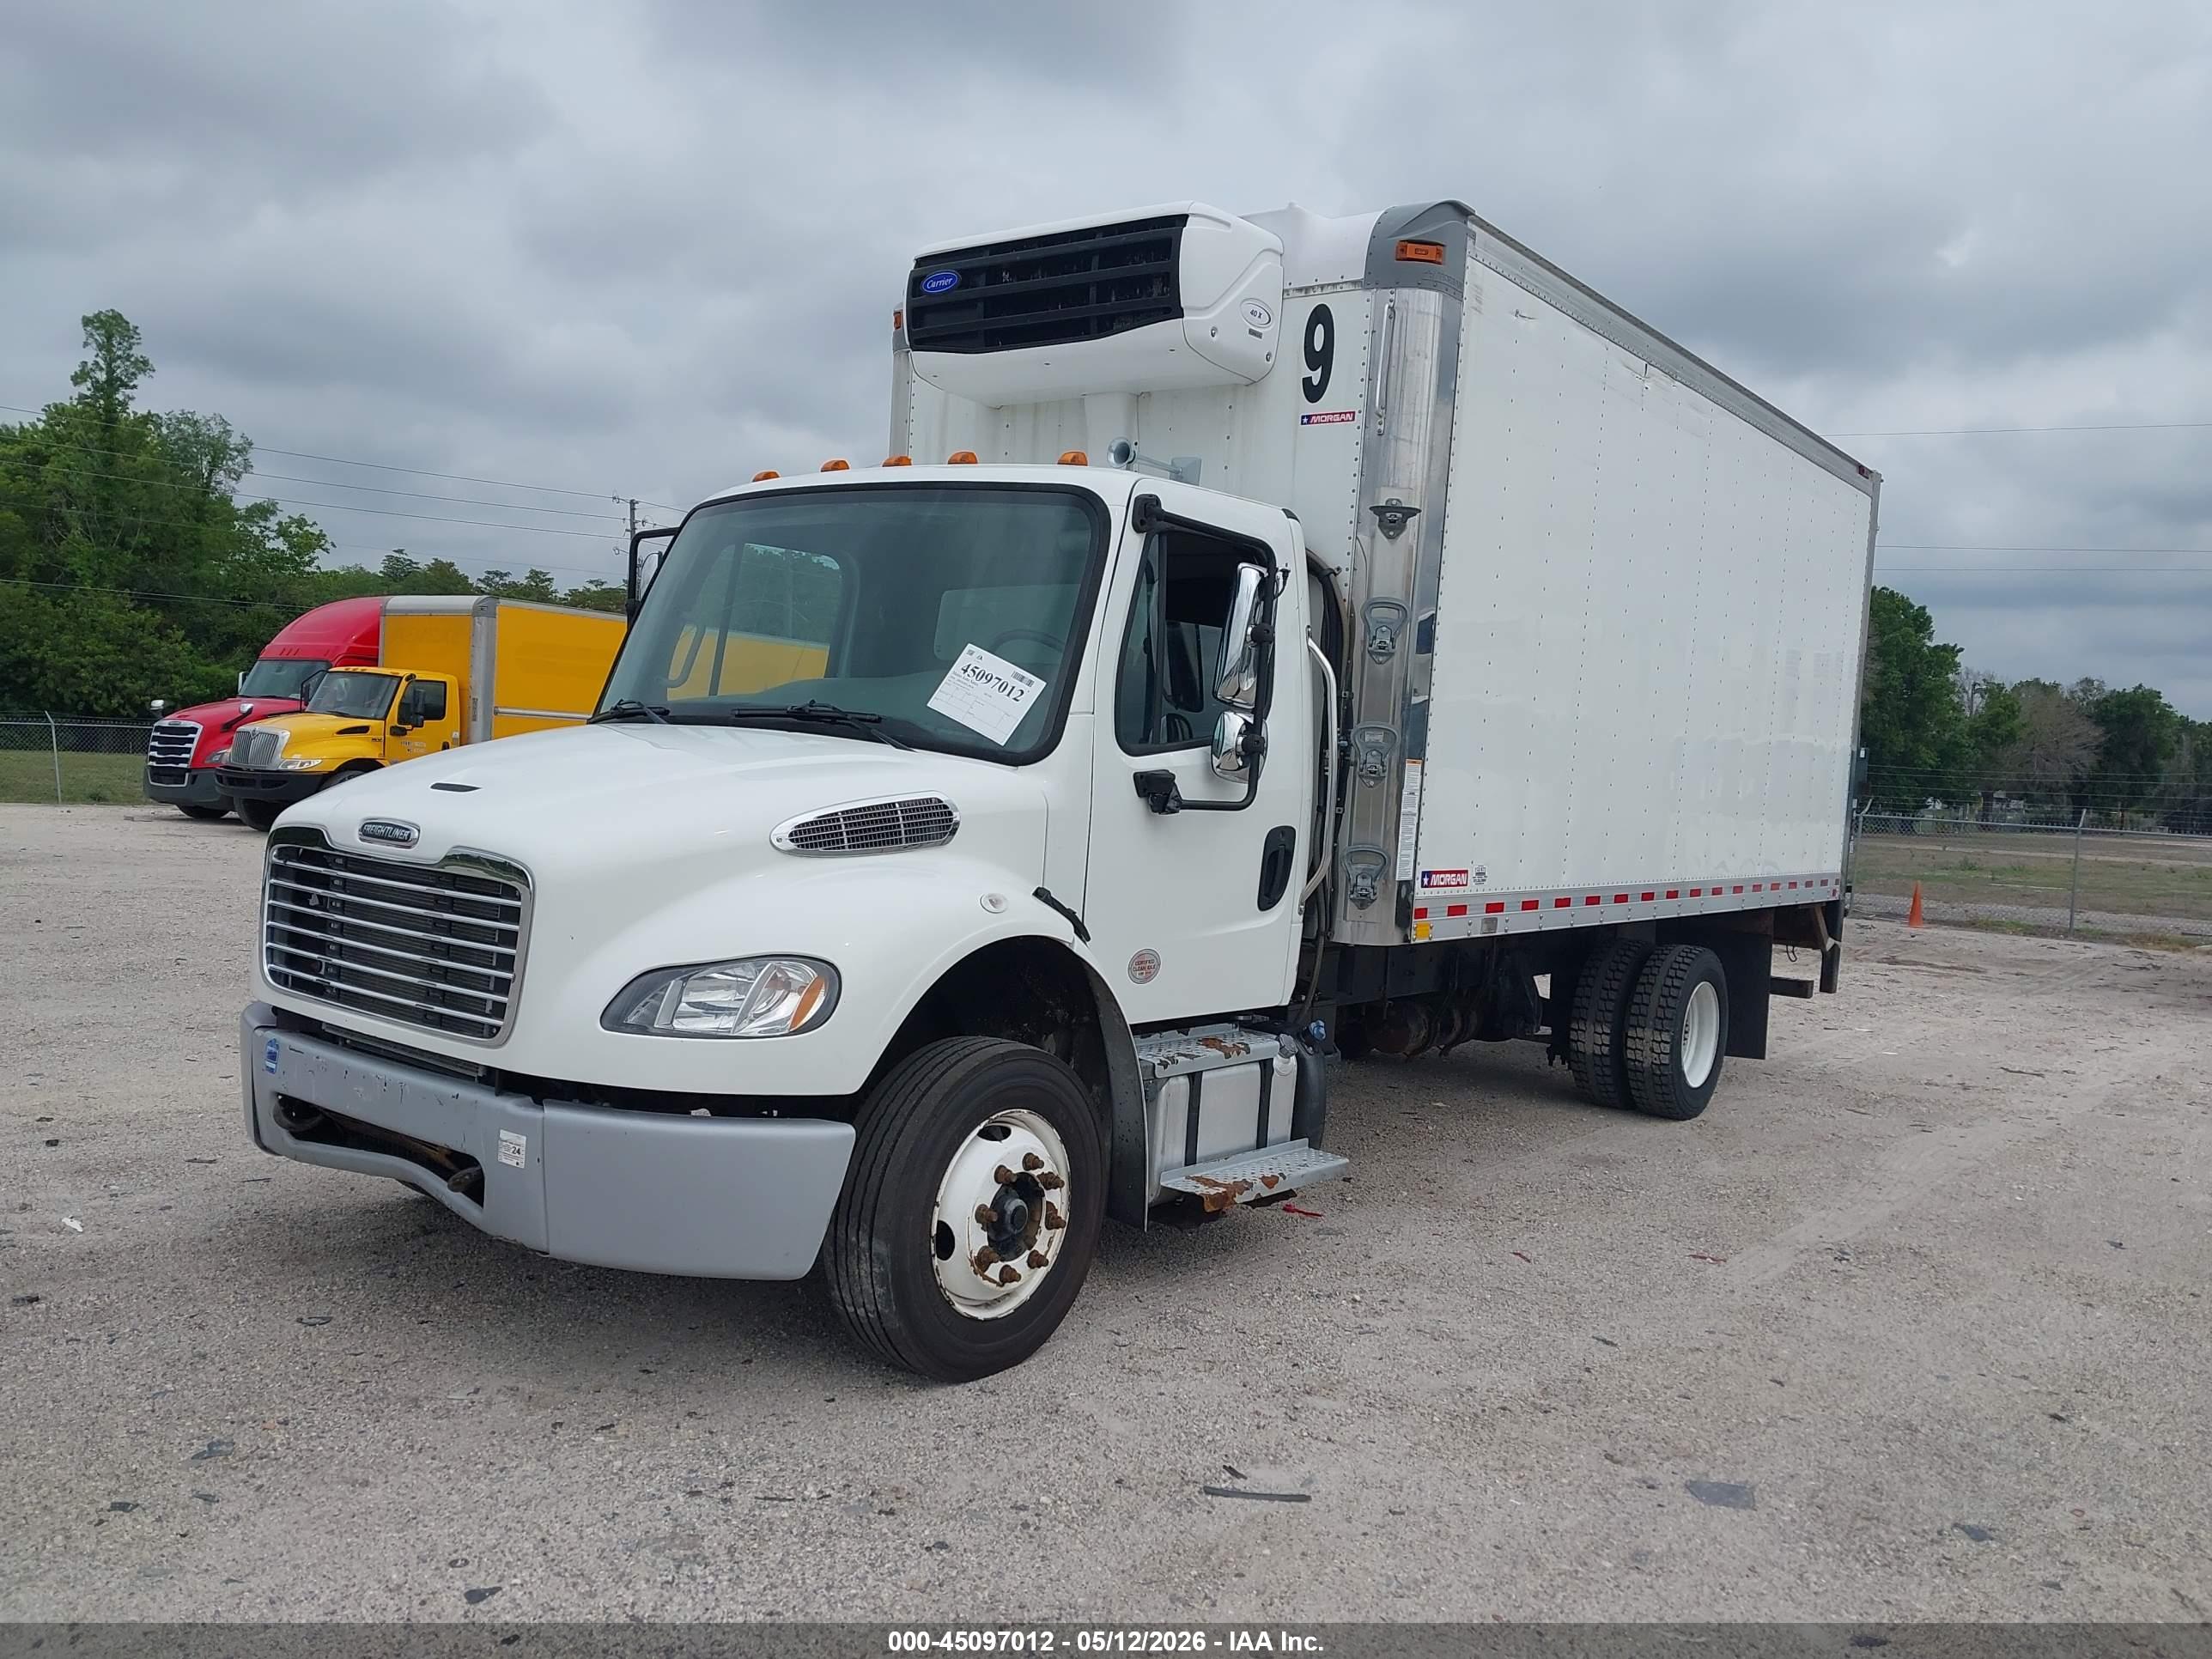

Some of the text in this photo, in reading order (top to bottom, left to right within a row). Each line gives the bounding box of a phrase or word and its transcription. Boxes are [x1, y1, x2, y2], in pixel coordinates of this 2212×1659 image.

[927, 276, 953, 289] Carrier
[1302, 303, 1335, 404] 9
[1310, 412, 1354, 423] MORGAN
[961, 664, 1024, 702] 45097012
[362, 824, 411, 841] FREIGHTLINER
[1430, 872, 1468, 886] MORGAN
[511, 1146, 521, 1155] 24
